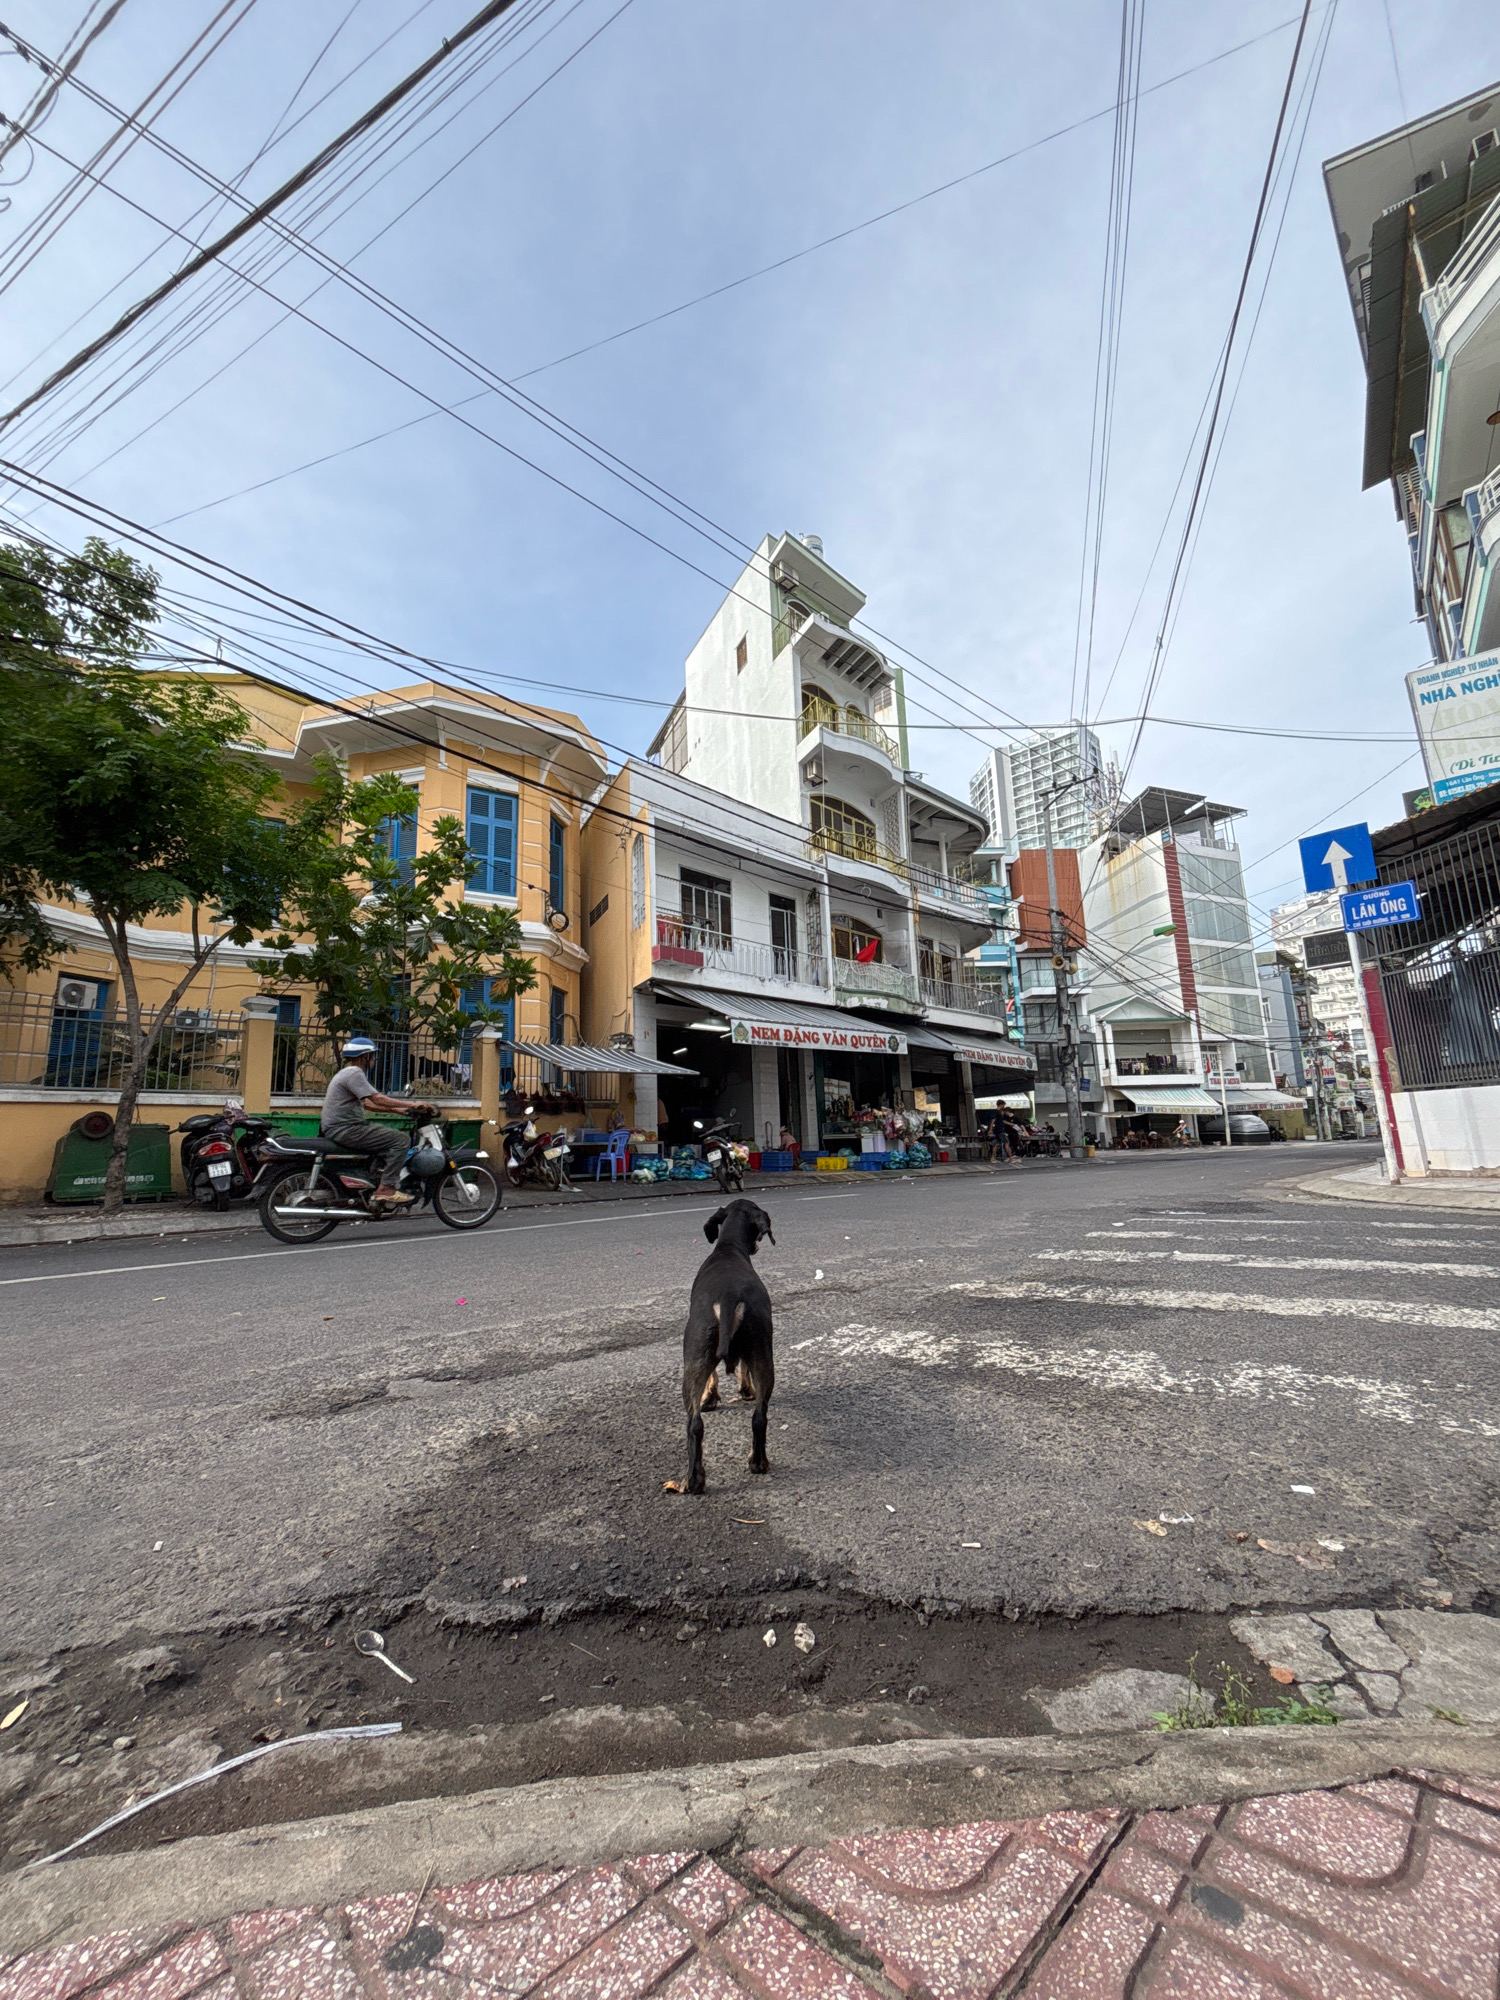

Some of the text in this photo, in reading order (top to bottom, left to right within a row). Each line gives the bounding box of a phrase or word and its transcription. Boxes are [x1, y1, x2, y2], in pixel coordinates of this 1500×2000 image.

[1417, 672, 1440, 686] DOANH
[1441, 665, 1466, 679] NGHIỆP
[1478, 657, 1498, 669] NHÂN
[1419, 669, 1500, 706] NHÀ NGH
[1362, 890, 1390, 900] ĐƯỜNG
[1351, 898, 1407, 920] LÃN ÔNG
[750, 1026, 887, 1049] NEM ĐẶNG VĂN QUYÊN
[962, 1048, 1026, 1066] NEM ĐẶNG VĂN QUYÊN
